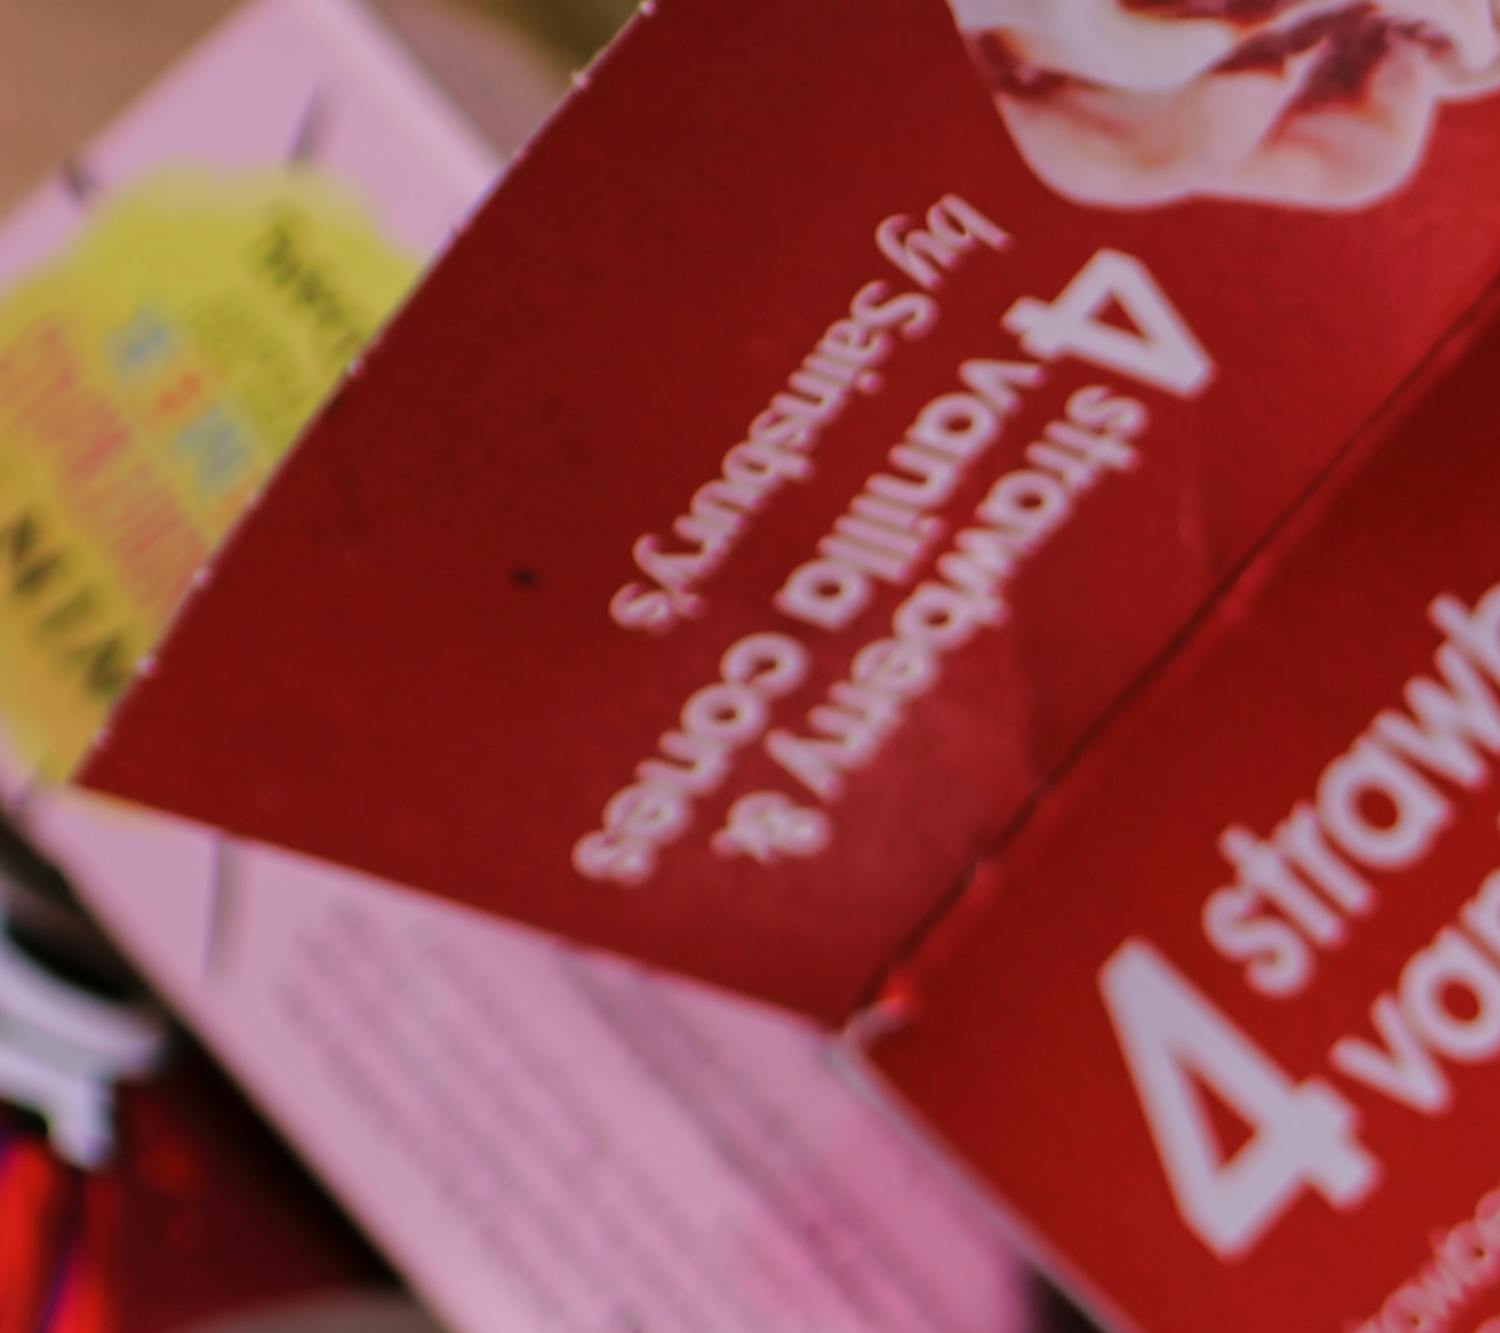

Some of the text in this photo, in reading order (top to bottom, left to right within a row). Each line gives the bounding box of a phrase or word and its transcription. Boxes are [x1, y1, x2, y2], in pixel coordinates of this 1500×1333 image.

[572, 357, 1041, 885] vanilla cones
[609, 193, 1008, 633] by Sainsbury's
[715, 248, 1213, 862] 4 strawberry &
[1096, 937, 1381, 1261] 4
